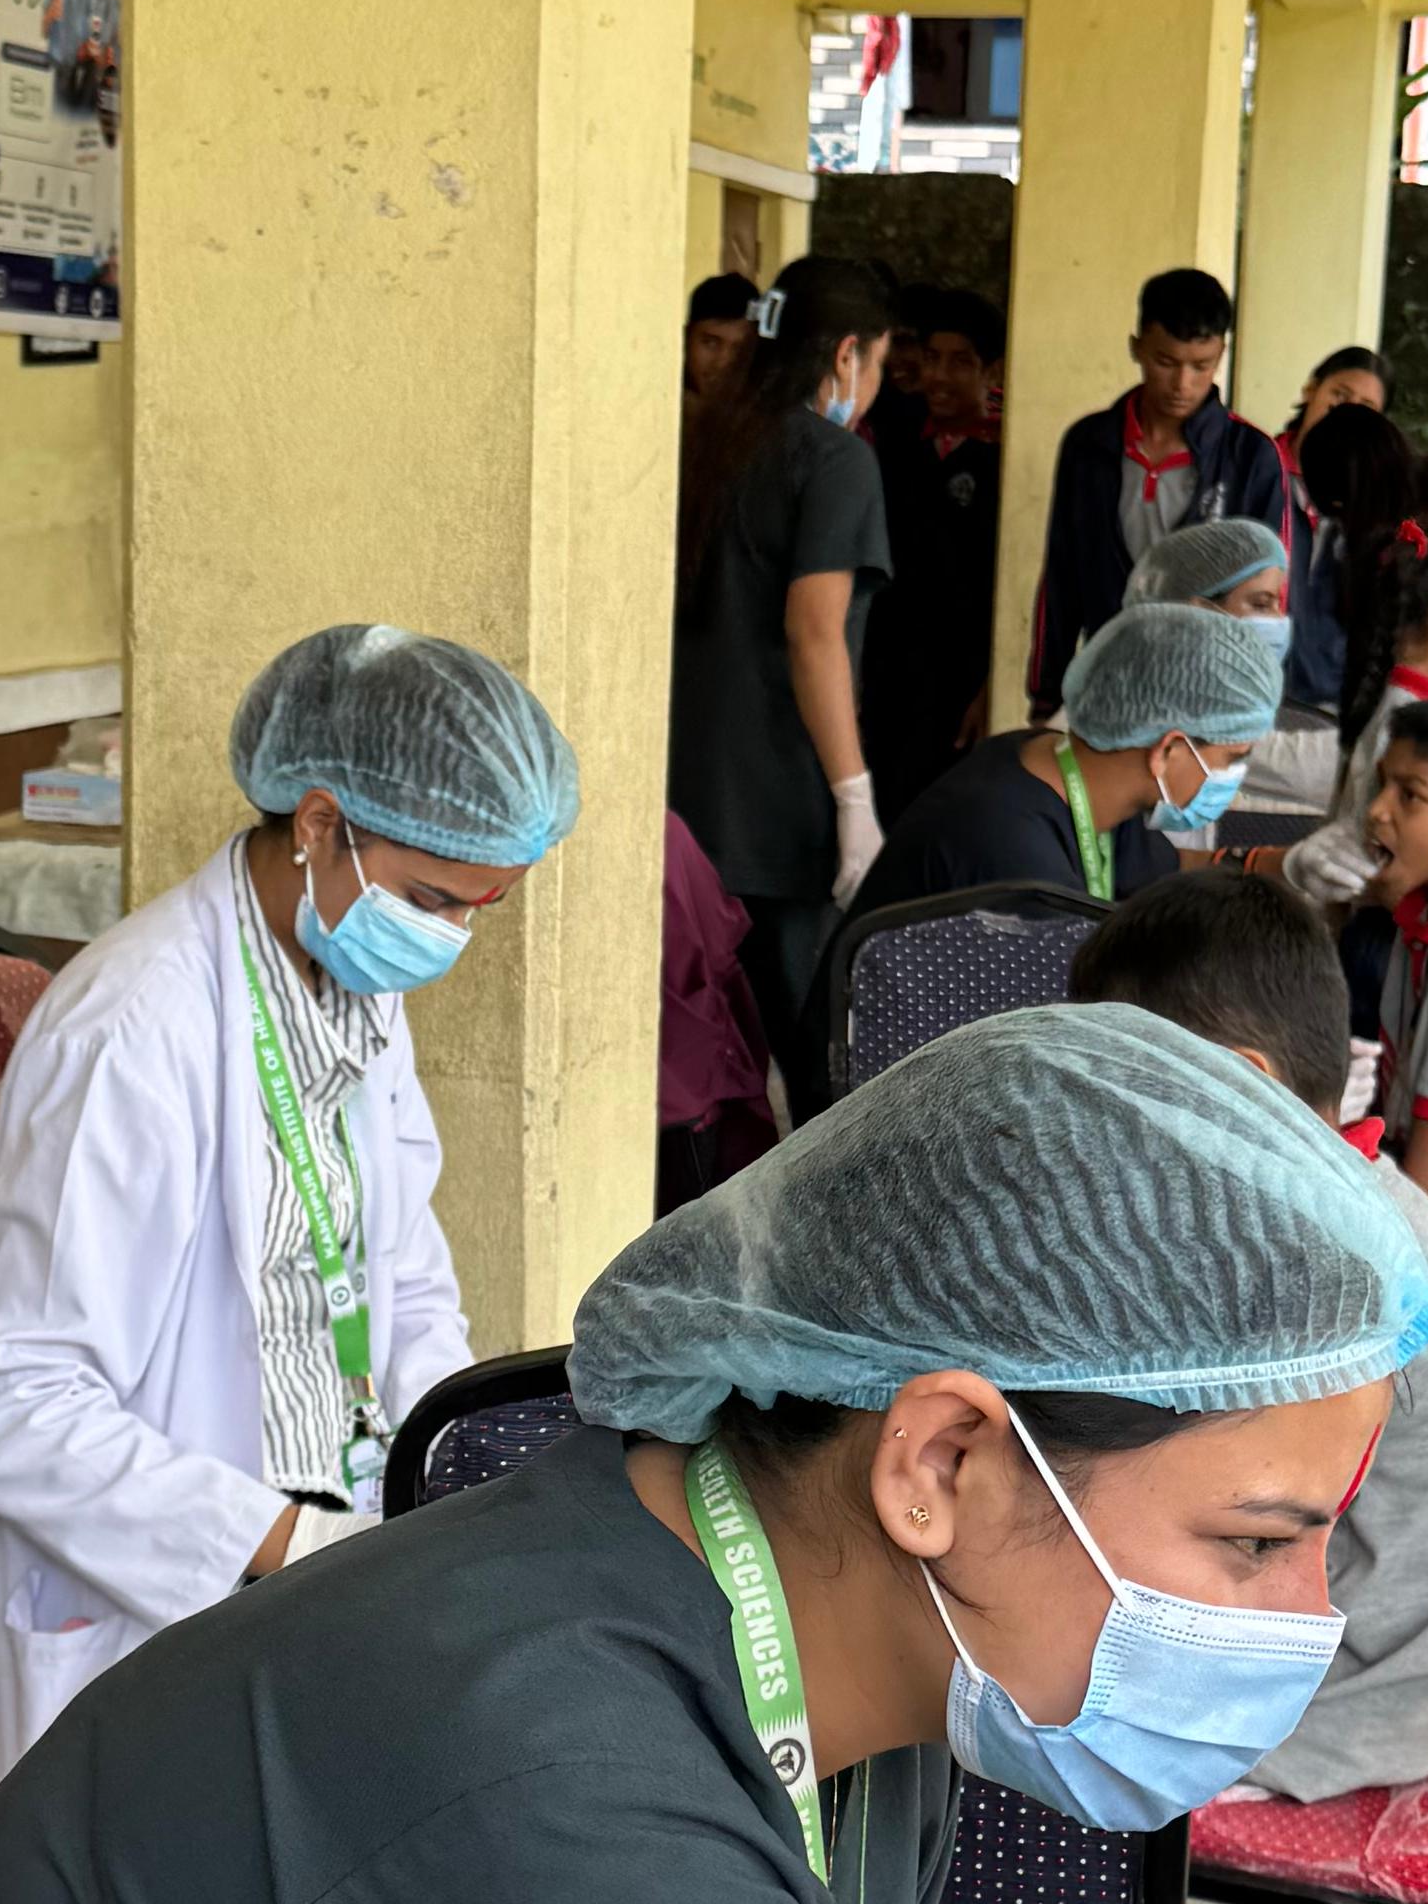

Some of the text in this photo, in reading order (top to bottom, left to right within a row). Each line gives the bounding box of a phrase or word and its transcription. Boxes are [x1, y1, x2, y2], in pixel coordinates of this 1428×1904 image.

[261, 1048, 280, 1071] OF
[270, 1077, 309, 1166] INSTITUTE
[724, 1541, 788, 1702] SCIENCES
